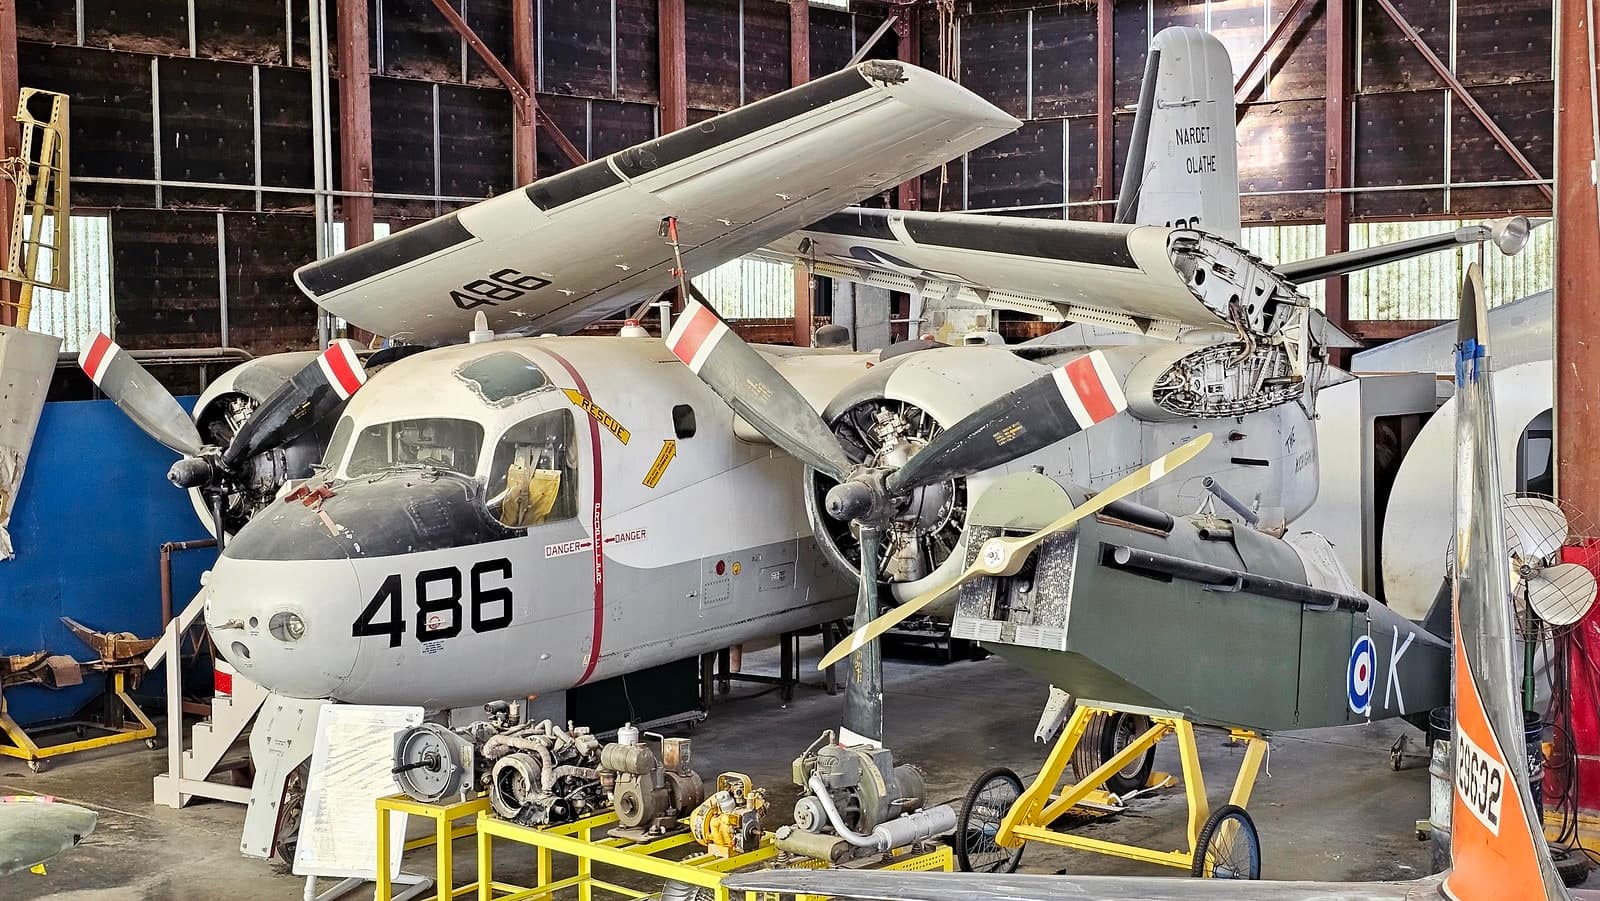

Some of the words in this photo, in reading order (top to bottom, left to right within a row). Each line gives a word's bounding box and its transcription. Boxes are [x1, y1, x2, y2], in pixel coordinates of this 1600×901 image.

[1175, 127, 1210, 145] NARDET
[1186, 156, 1216, 174] OLATHE
[450, 269, 552, 310] 486
[581, 399, 625, 439] RESCUE
[546, 542, 580, 557] DANGER
[594, 503, 602, 584] PROPELLER
[615, 530, 646, 543] DANGER
[352, 558, 513, 648] 486
[1384, 624, 1415, 715] K
